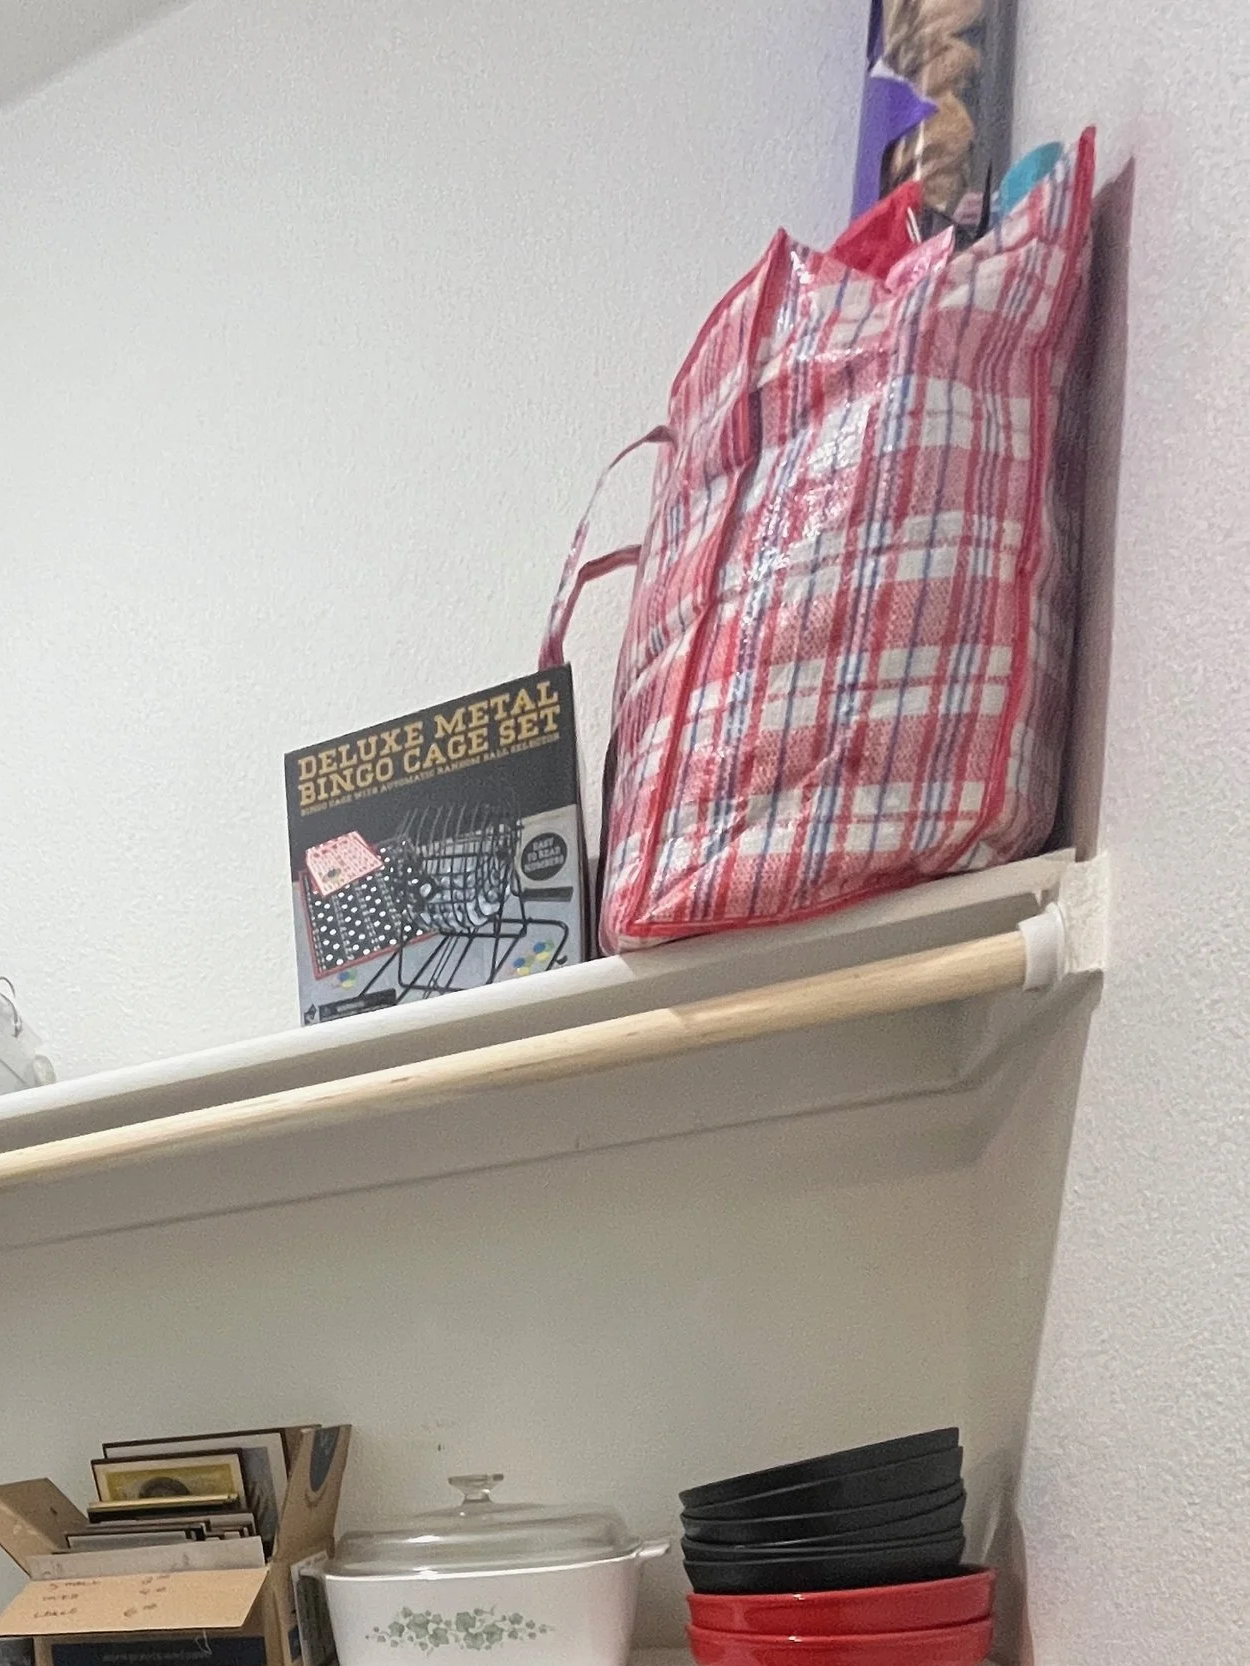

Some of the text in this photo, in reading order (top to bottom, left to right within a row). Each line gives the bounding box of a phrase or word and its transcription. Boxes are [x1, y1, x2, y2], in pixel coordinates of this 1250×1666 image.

[297, 680, 559, 781] DELUXE METAL
[297, 705, 560, 806] BINGO CAGE SET
[353, 786, 378, 800] WITH
[380, 767, 435, 794] AUTOMATIC
[437, 755, 480, 775] RANDOM
